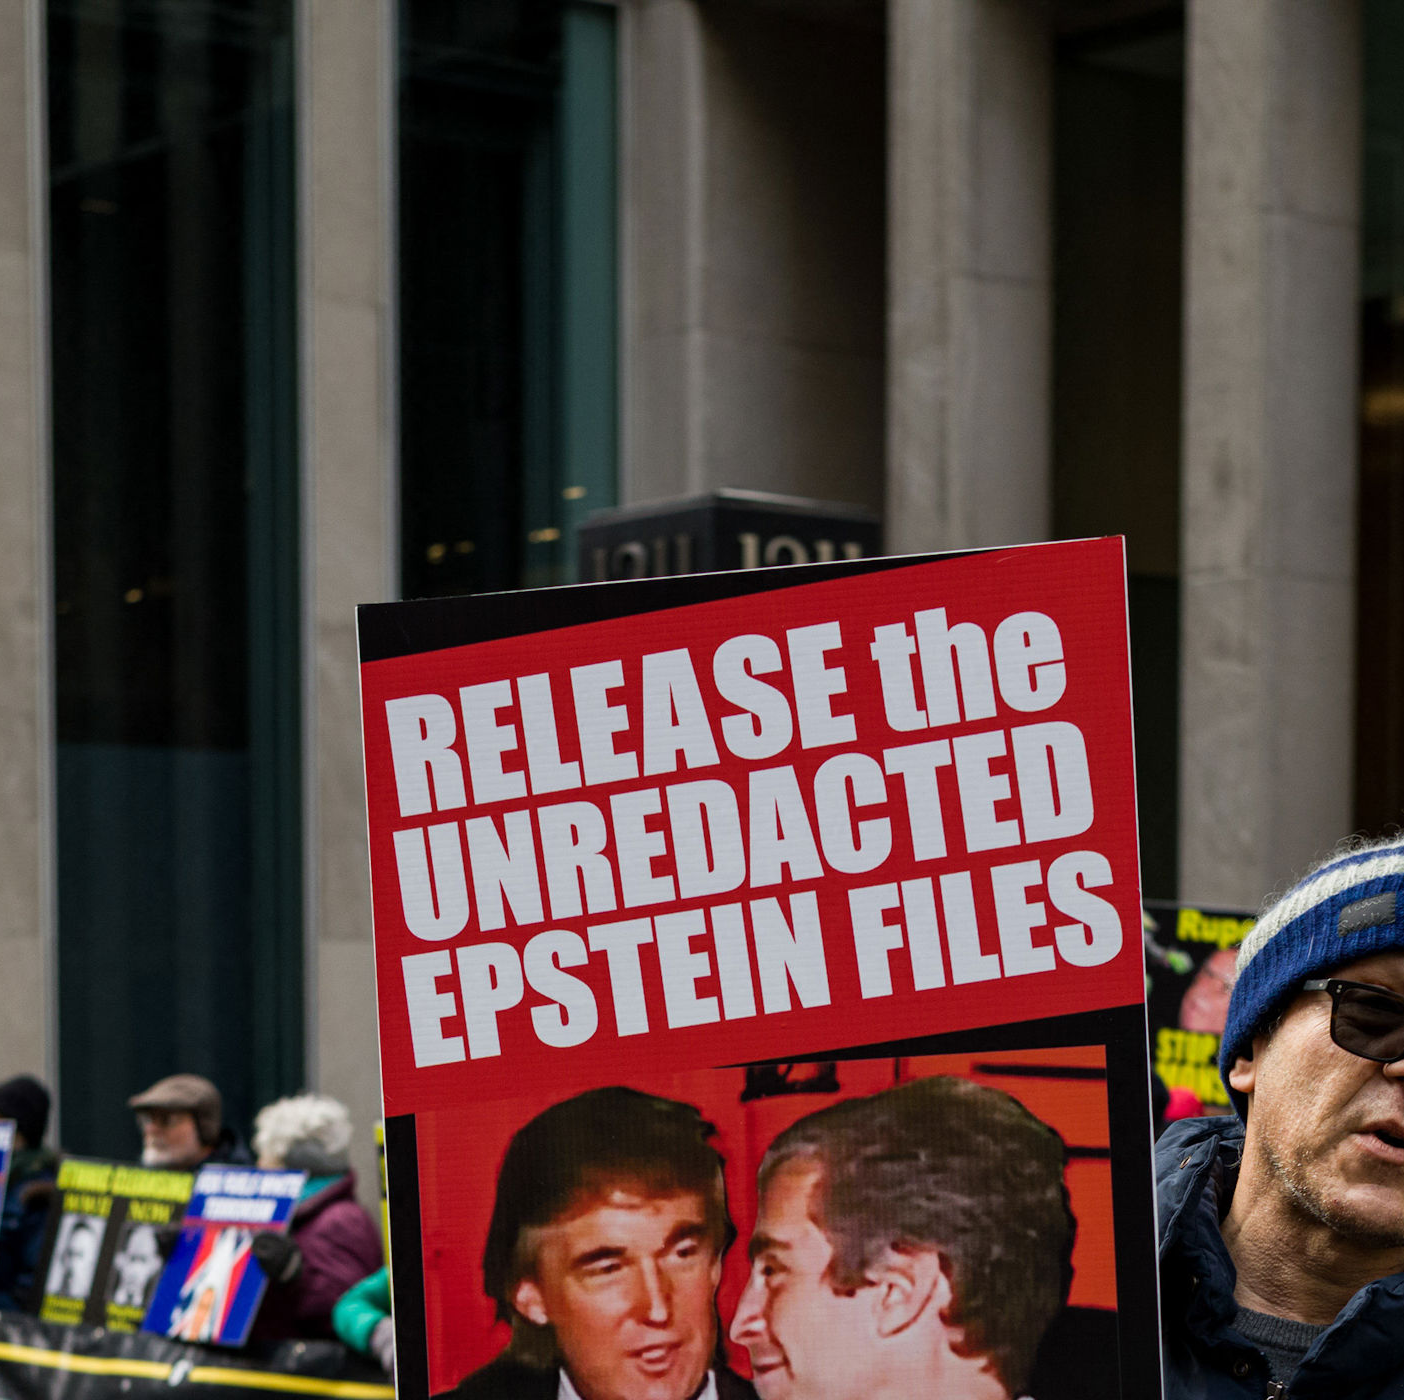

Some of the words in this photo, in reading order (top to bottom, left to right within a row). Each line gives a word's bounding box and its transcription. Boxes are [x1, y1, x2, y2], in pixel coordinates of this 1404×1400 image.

[385, 620, 857, 818] RELEASE
[870, 607, 1067, 732] the
[392, 720, 1096, 942] UNREDACTED
[401, 893, 832, 1068] EPSTEIN
[848, 849, 1123, 999] FILES
